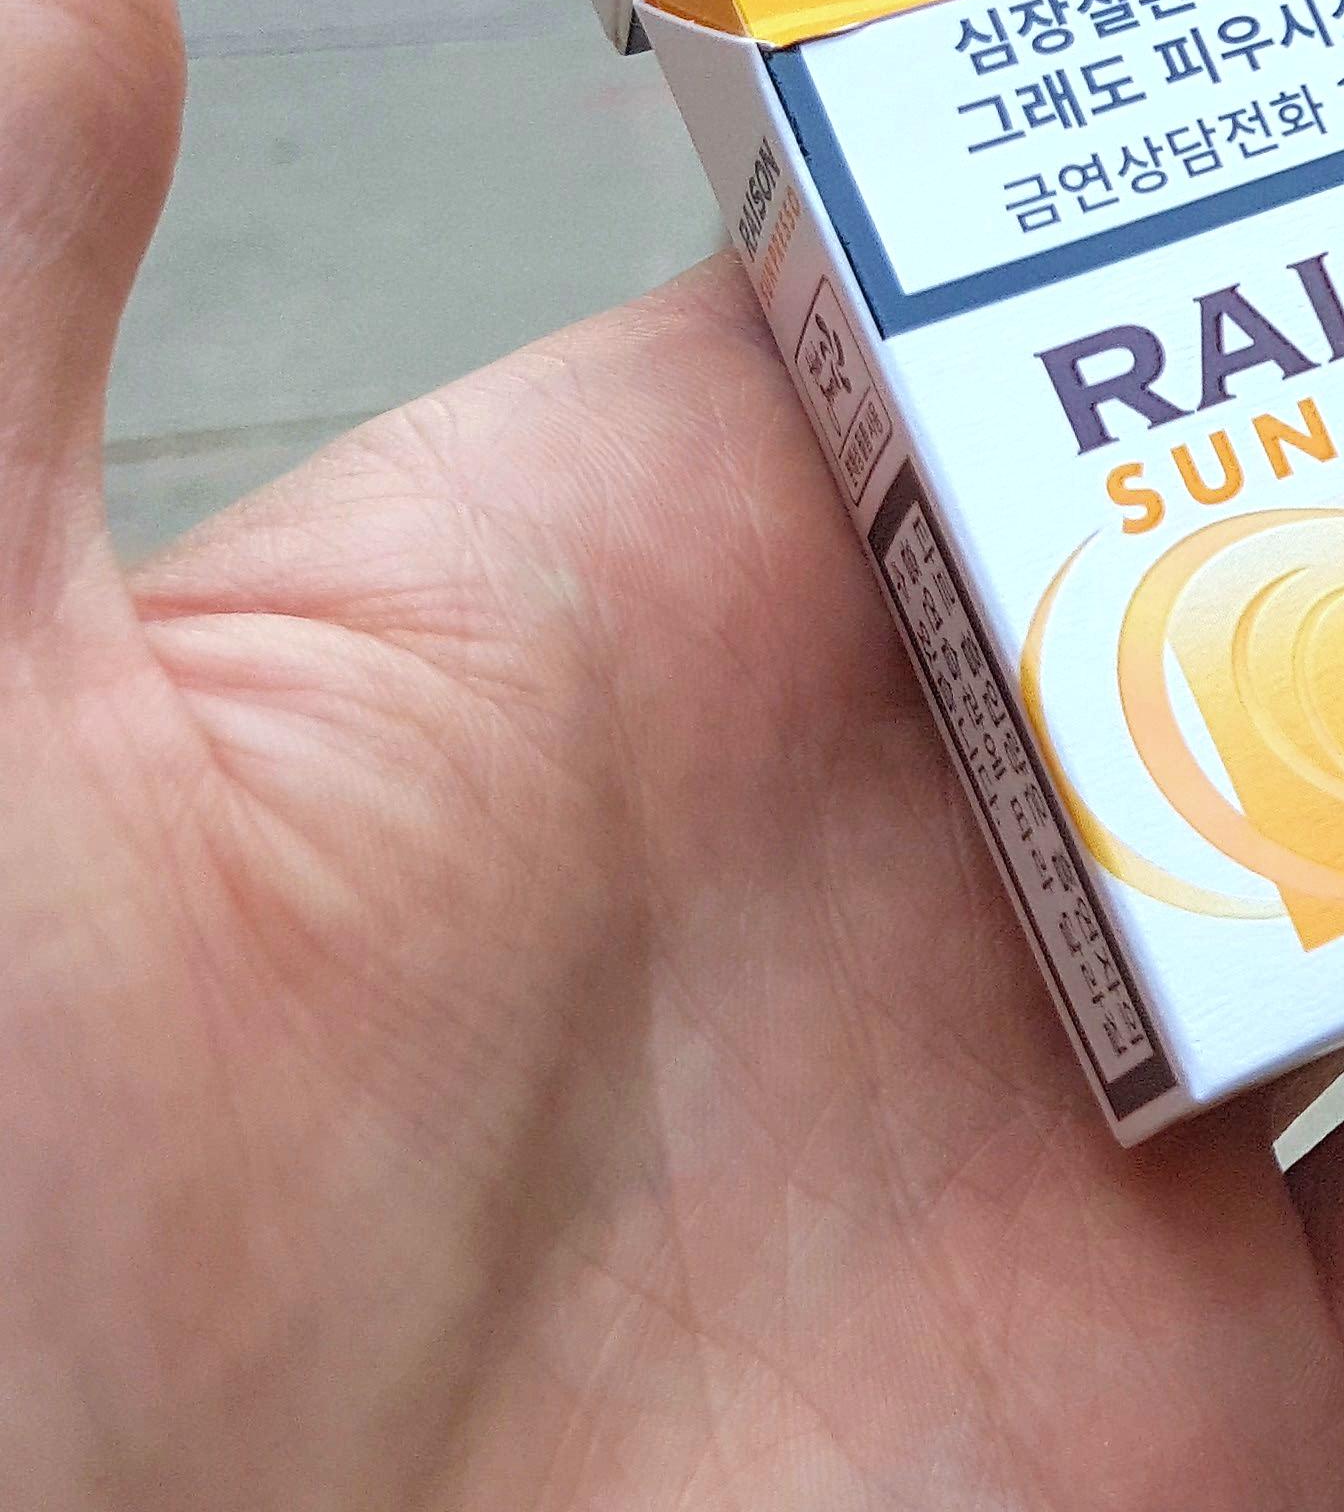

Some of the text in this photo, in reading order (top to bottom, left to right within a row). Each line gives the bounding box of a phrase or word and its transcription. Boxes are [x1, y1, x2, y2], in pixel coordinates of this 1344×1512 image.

[957, 54, 1148, 155] 그래도
[1003, 84, 1329, 234] 금연상담전화
[738, 135, 781, 264] RAISON
[1105, 397, 1340, 536] SUN
[900, 538, 1006, 781] 흡연습관에
[1009, 796, 1055, 893] 따라
[912, 514, 1146, 1046] 타르 흡입량은 흡연자의
